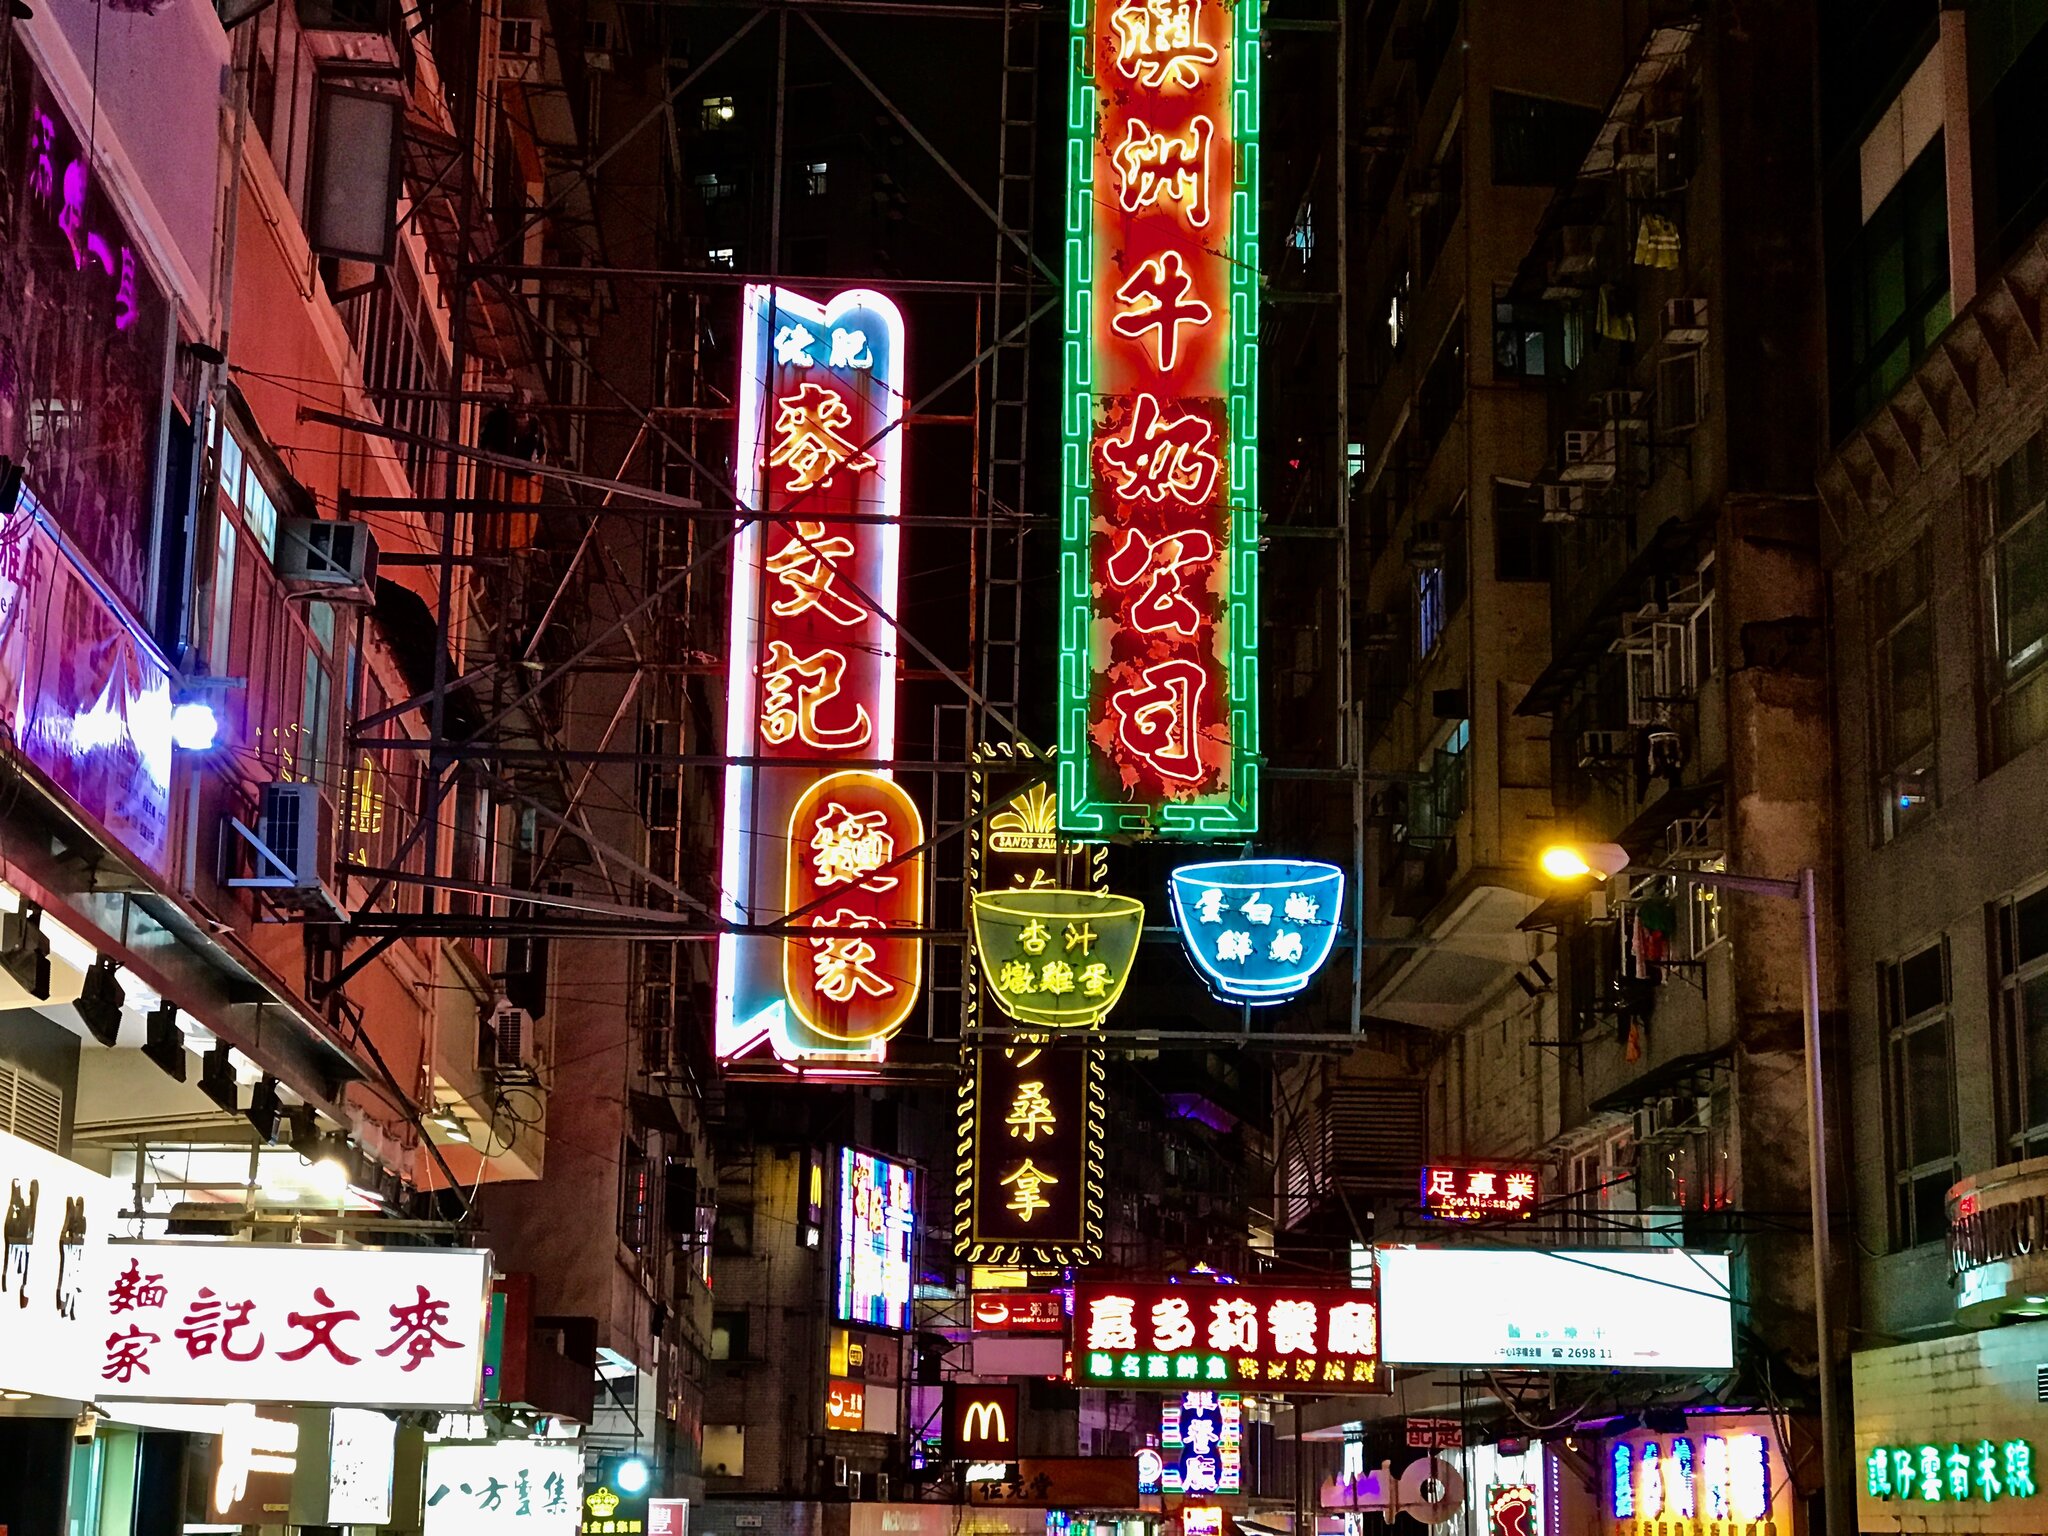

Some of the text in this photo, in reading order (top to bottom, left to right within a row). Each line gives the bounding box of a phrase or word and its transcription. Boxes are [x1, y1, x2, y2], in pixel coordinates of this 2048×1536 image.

[999, 837, 1034, 849] SANDS
[1018, 918, 1098, 957] 杏汁
[1567, 1348, 1596, 1359] 2698
[428, 1469, 568, 1517] 八方雲集
